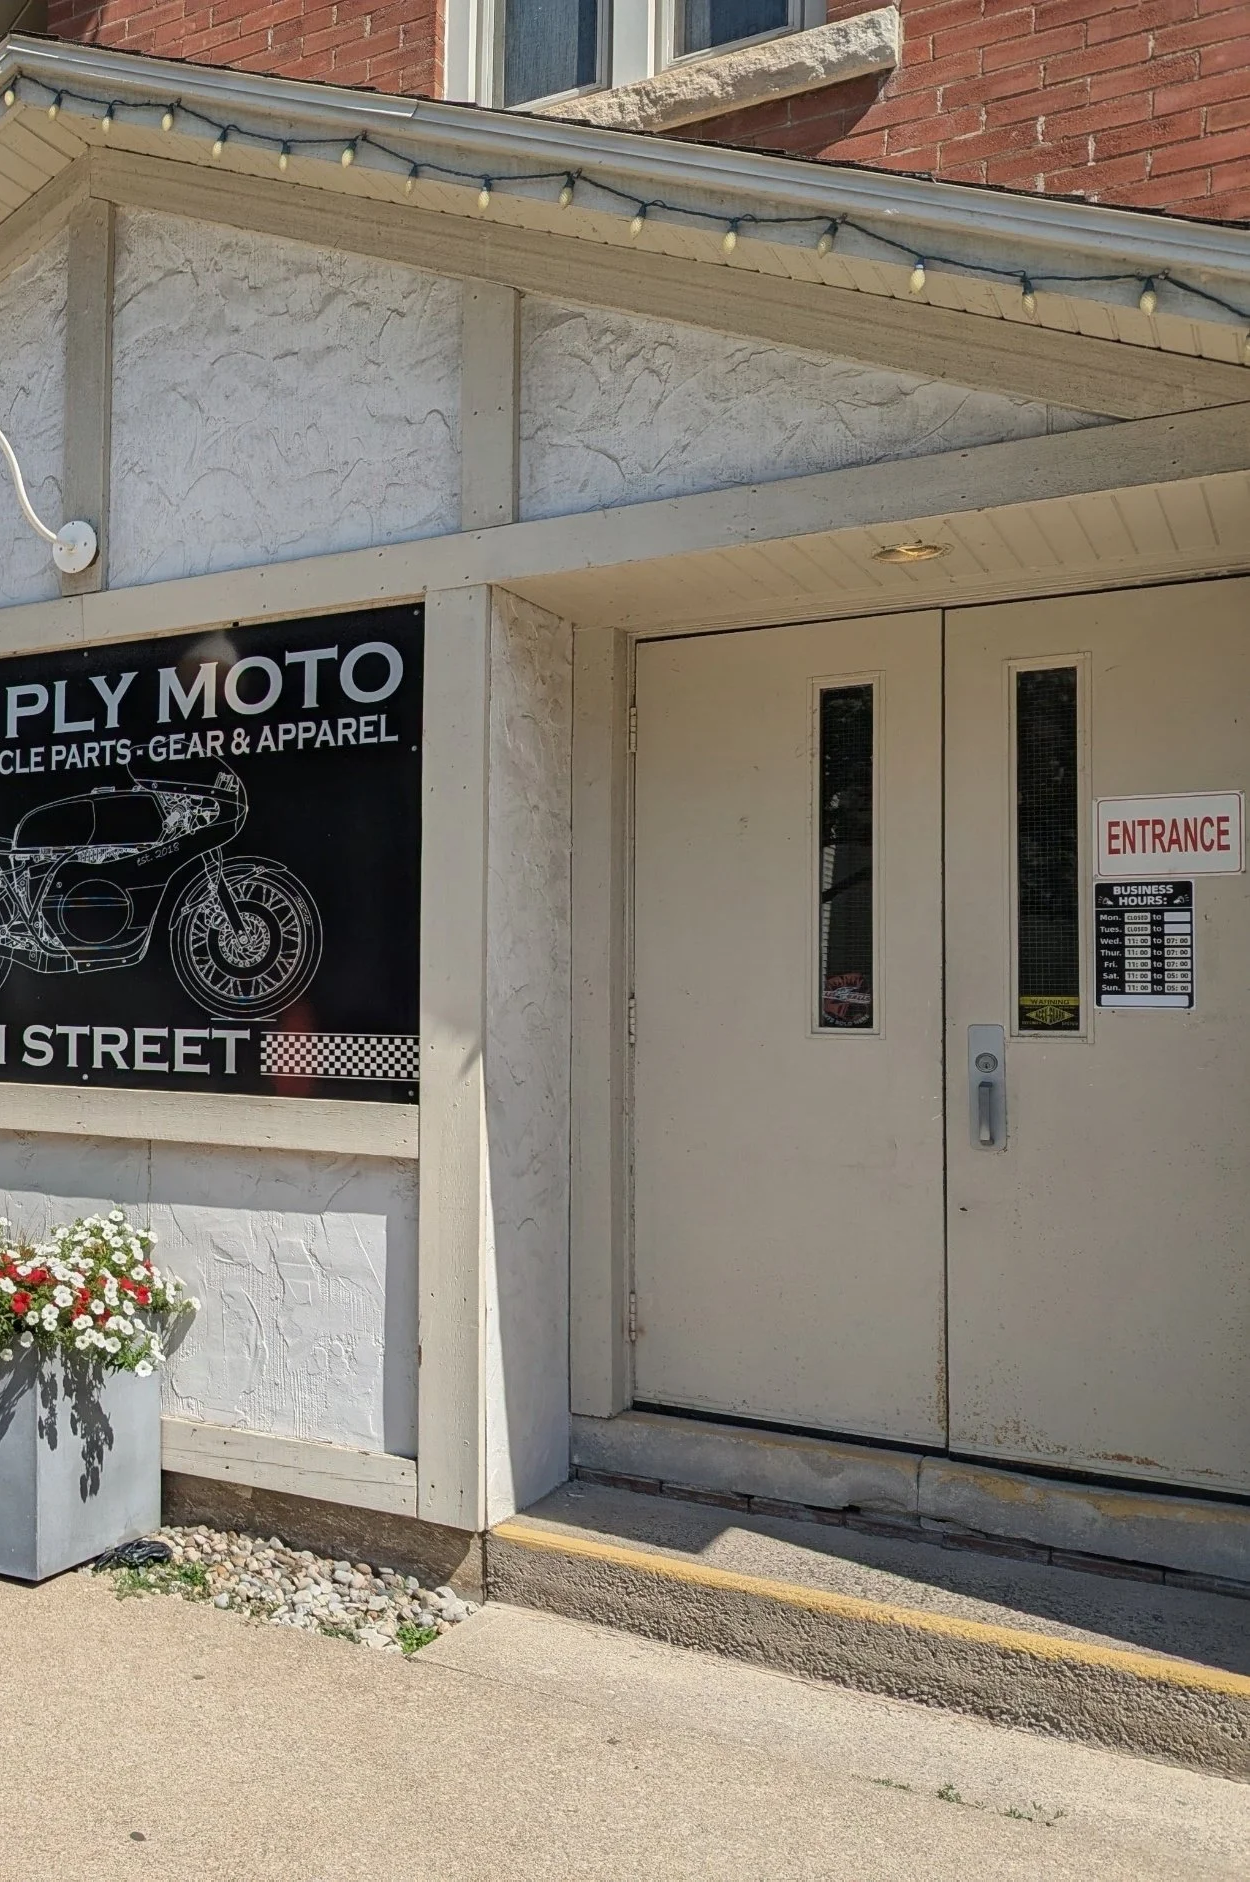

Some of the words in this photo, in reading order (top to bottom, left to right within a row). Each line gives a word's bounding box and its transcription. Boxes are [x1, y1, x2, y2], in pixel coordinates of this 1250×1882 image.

[157, 641, 404, 723] MOTO
[51, 739, 132, 771] PARTS
[148, 731, 223, 763] GEAR
[230, 730, 250, 756] &
[256, 714, 398, 753] APPAREL
[155, 842, 180, 859] 2018
[1107, 816, 1231, 855] ENTRANCE
[1113, 885, 1174, 895] BUSINESS
[1118, 896, 1168, 905] HOURS:
[22, 1025, 251, 1075] STREET
